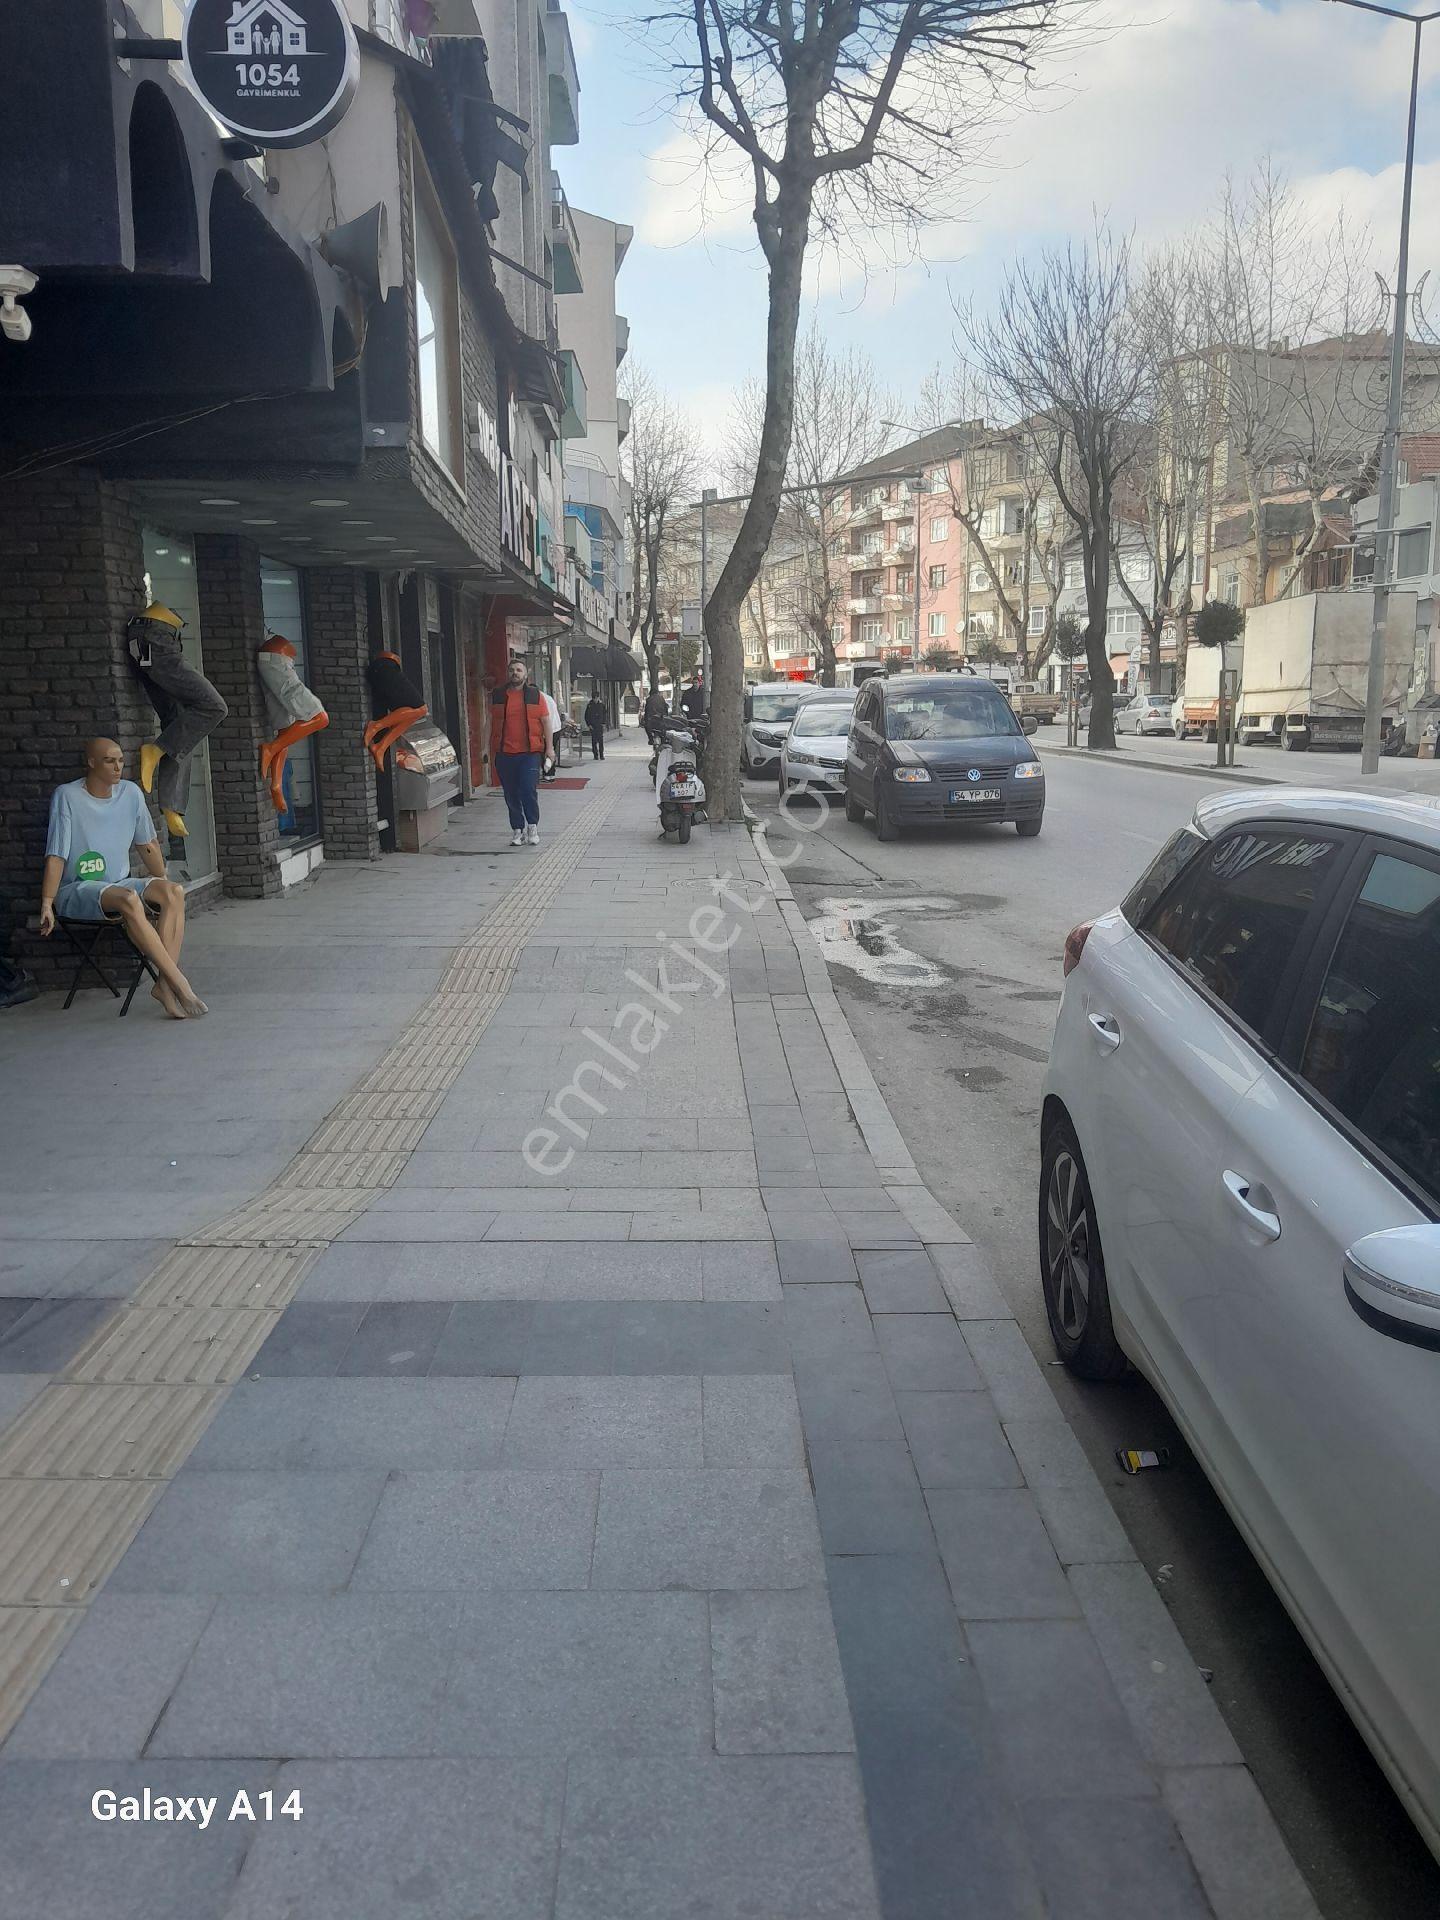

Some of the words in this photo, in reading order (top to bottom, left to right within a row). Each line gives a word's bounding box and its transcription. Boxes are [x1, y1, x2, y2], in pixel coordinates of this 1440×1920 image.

[236, 63, 300, 86] 1054
[954, 791, 965, 800] 54
[969, 790, 981, 799] YP
[983, 789, 1000, 798] 076
[79, 858, 105, 874] 250
